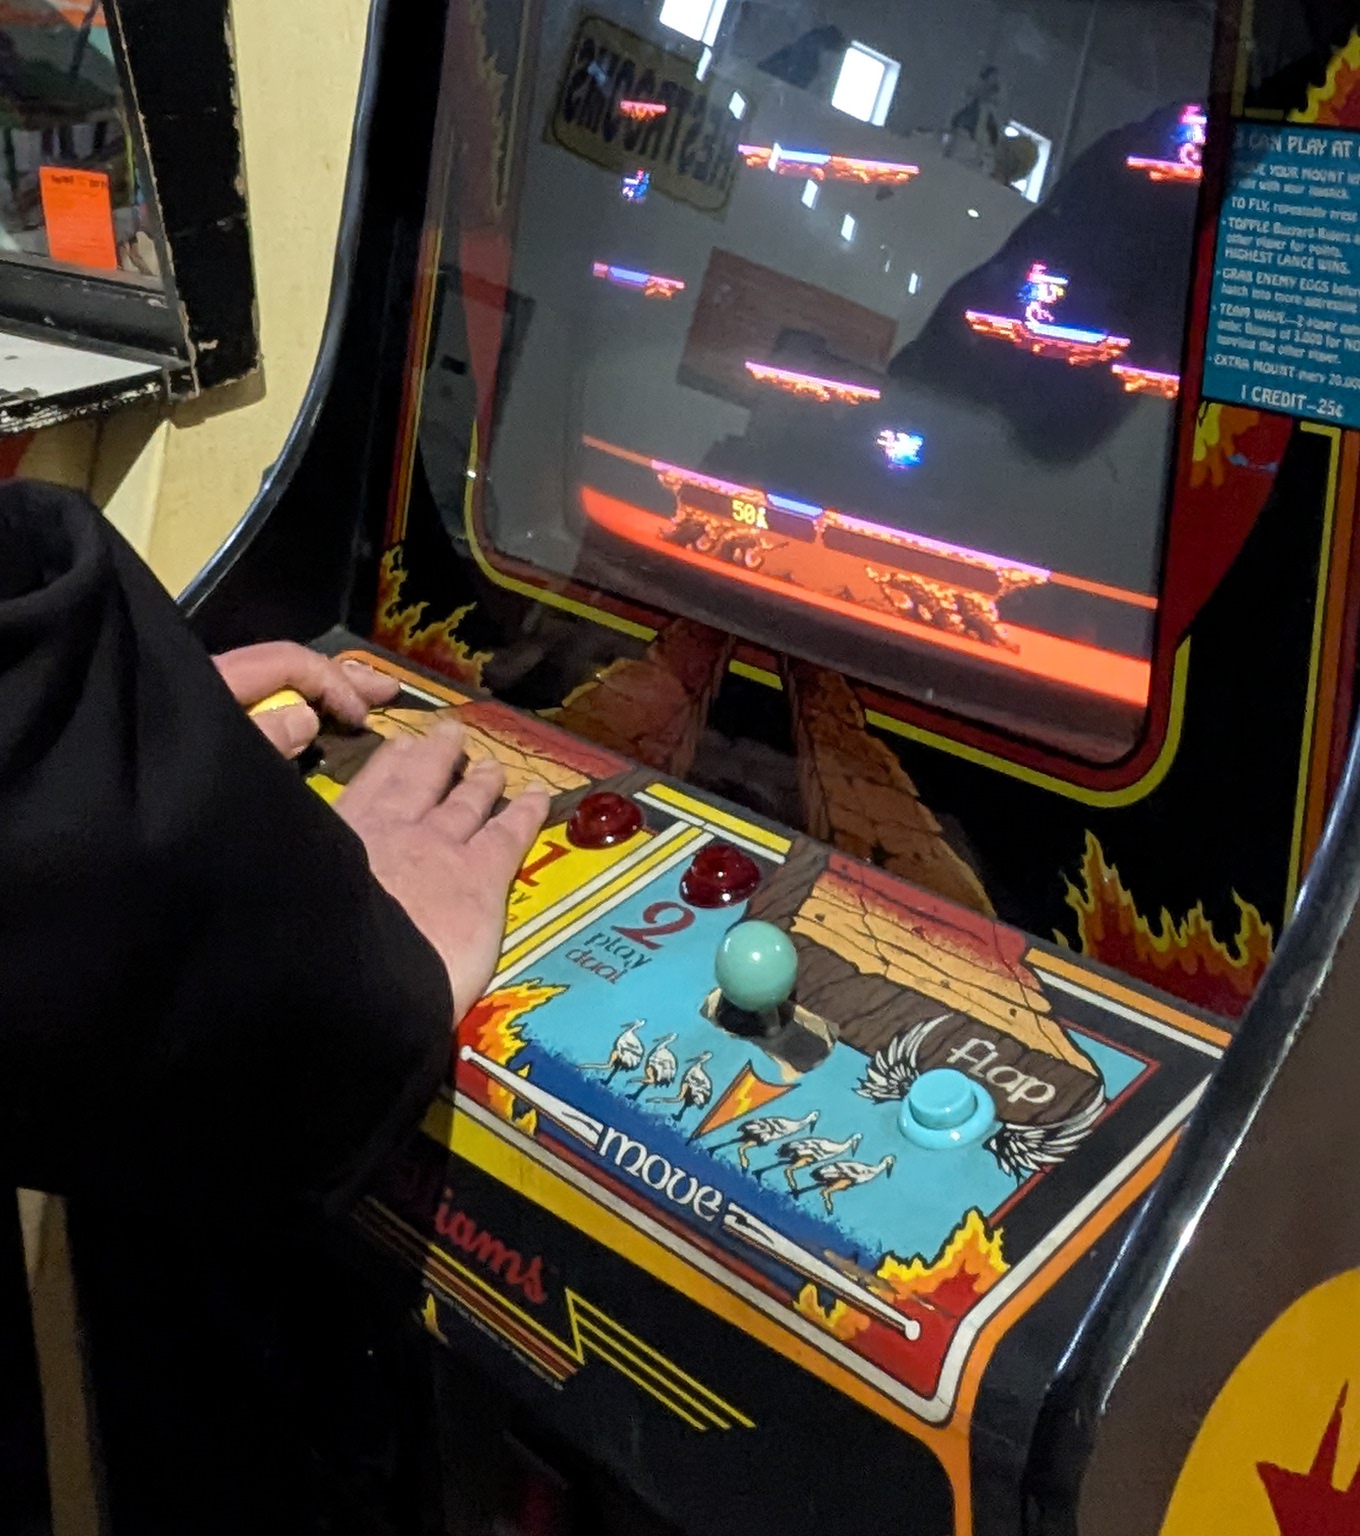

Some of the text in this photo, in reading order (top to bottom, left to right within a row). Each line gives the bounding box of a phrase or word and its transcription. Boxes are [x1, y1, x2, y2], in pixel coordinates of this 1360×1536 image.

[1287, 134, 1328, 156] PLAY
[1332, 139, 1355, 159] AT
[1231, 196, 1246, 210] TO
[1252, 360, 1296, 379] MOUNT
[732, 499, 756, 525] 50
[516, 840, 572, 888] 1
[610, 901, 696, 951] 2
[583, 931, 653, 970] play
[945, 1037, 1057, 1106] flap
[596, 1126, 727, 1223] move
